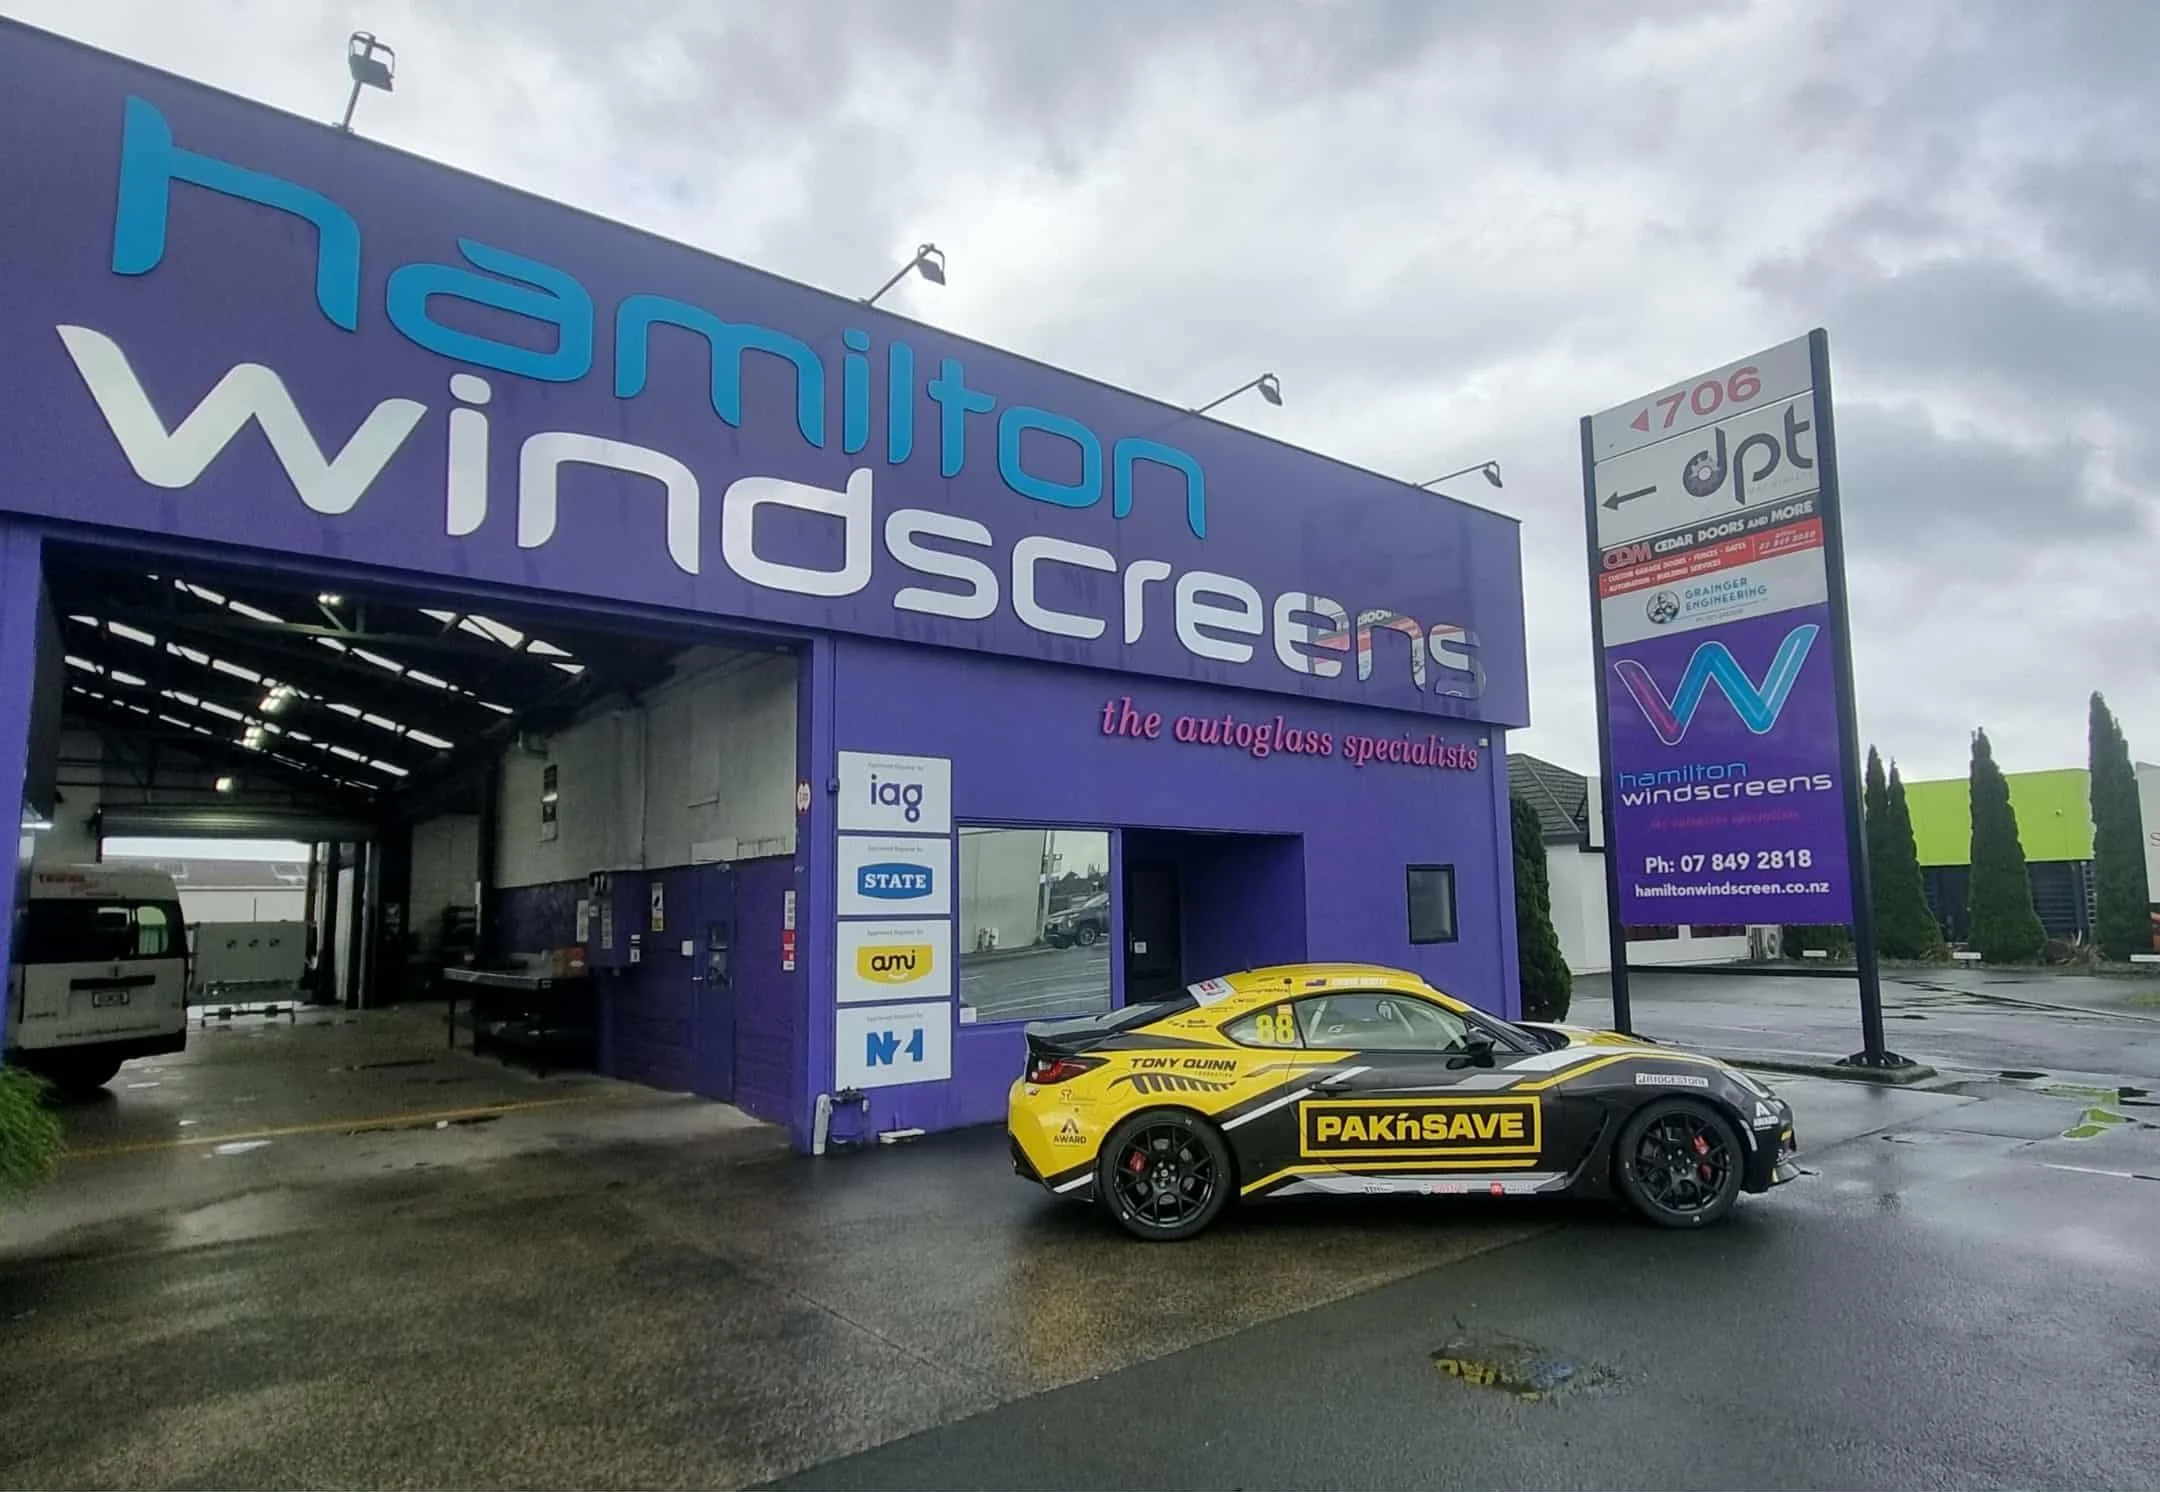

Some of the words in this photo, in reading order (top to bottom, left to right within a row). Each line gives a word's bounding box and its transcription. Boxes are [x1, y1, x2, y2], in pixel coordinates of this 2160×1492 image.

[112, 94, 1206, 538] hamilton
[1656, 366, 1761, 428] 706
[1683, 404, 1814, 506] dpt
[56, 324, 1487, 701] windscreens
[1603, 541, 1652, 570] CDM
[1654, 534, 1693, 553] CEDAR
[1697, 520, 1745, 542] DOORS
[1747, 516, 1769, 530] AND
[1771, 501, 1814, 523] MORE
[1684, 577, 1749, 600] GRAINGER
[1685, 584, 1768, 612] ENGINEERING
[1102, 696, 1161, 738] the
[1174, 714, 1334, 758] autoglass
[1343, 731, 1479, 770] specialists
[1618, 761, 1748, 789] hamilton
[1621, 772, 1832, 807] windscreens
[870, 774, 923, 823] iag
[1645, 856, 1674, 874] Ph:
[1680, 854, 1705, 872] 07
[1711, 852, 1750, 871] 849
[1757, 849, 1812, 868] 2818
[864, 872, 927, 889] STATE
[1635, 880, 1830, 898] hamiltonwindscreen.co.nz
[871, 948, 916, 972] ami
[1256, 1014, 1296, 1044] 88
[1131, 1058, 1180, 1069] TONY
[1183, 1059, 1237, 1071] QUINN
[1053, 1134, 1088, 1145] AWARD
